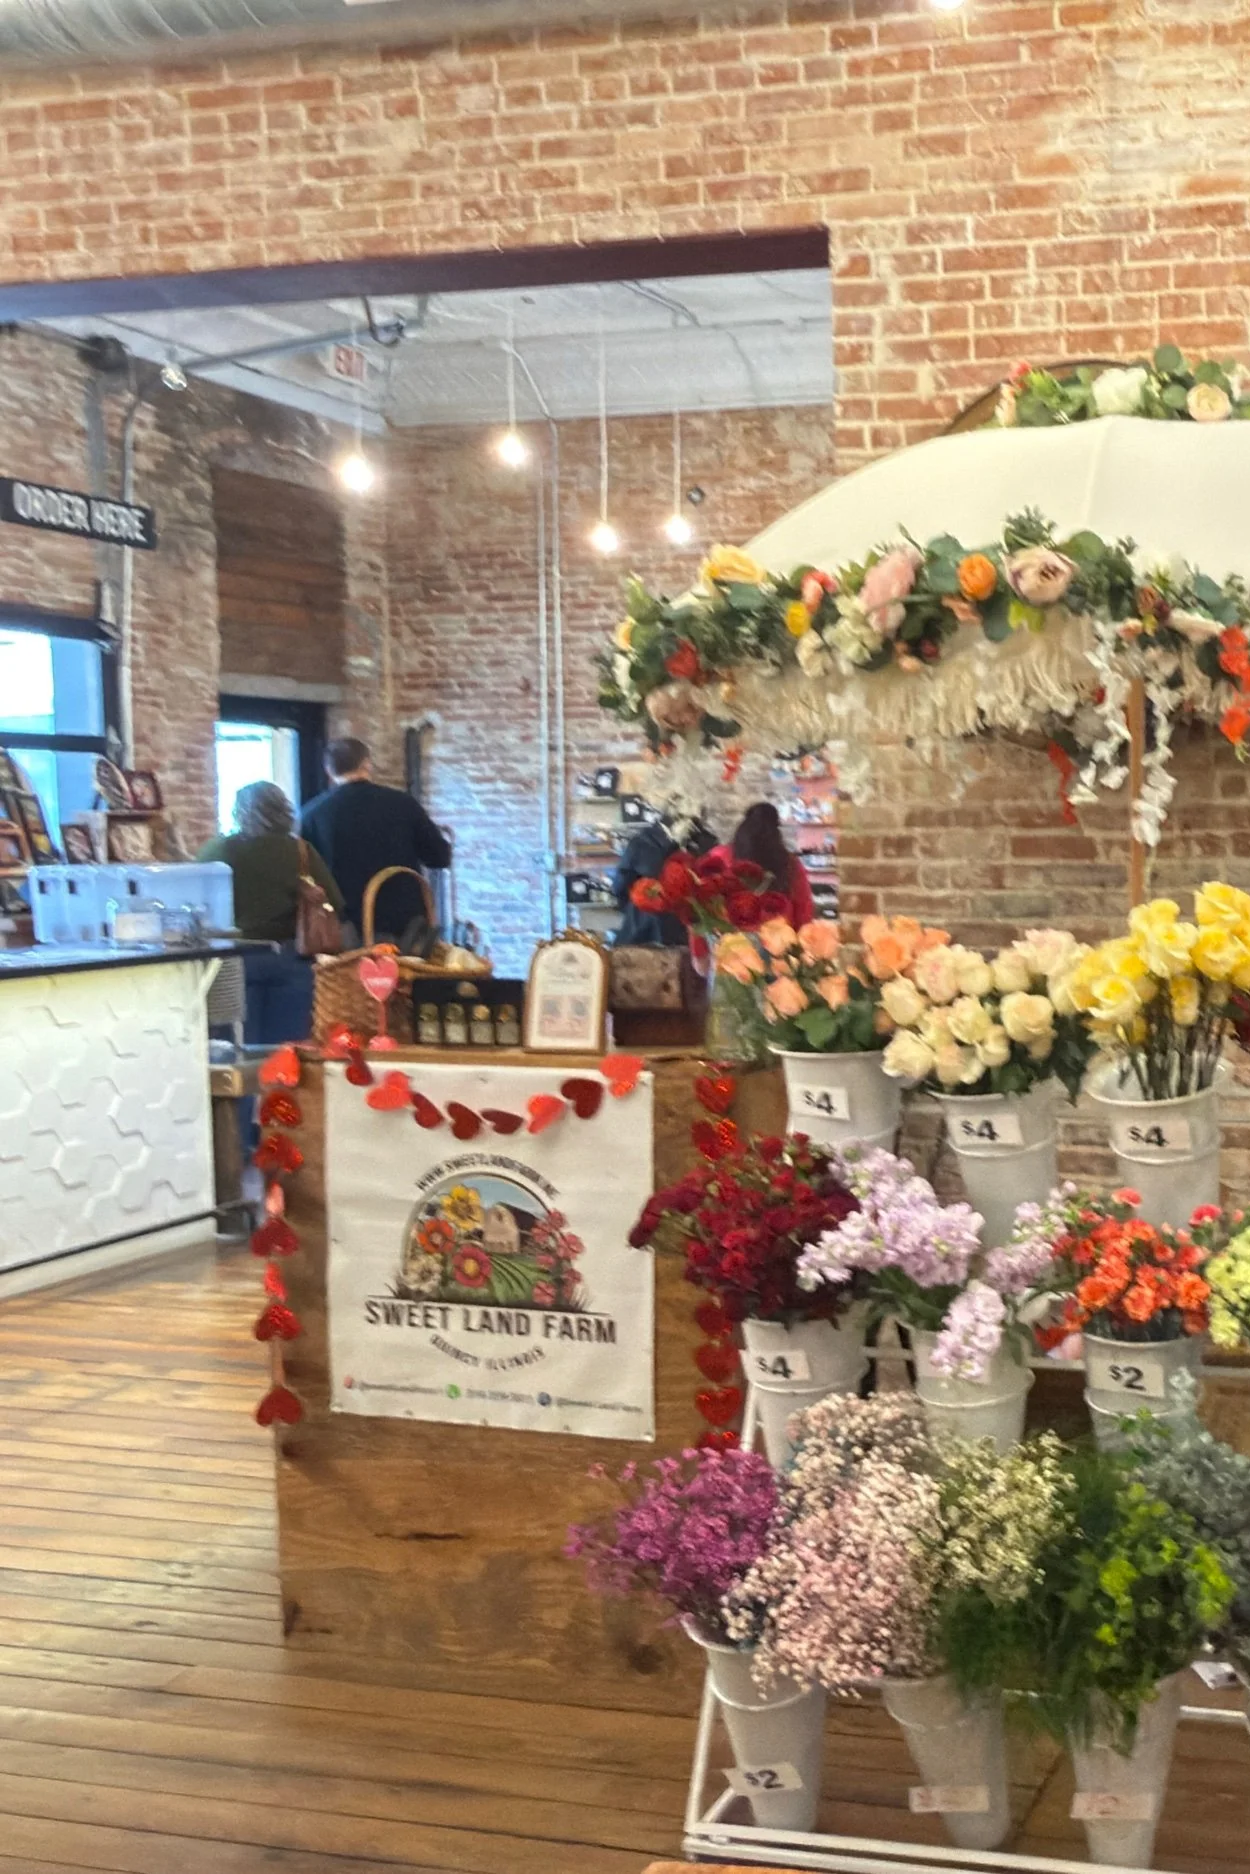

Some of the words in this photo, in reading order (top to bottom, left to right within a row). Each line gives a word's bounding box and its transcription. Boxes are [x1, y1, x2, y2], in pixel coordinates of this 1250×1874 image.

[13, 482, 91, 532] ORDER
[90, 499, 148, 544] HERE
[803, 1090, 836, 1115] $4
[961, 1119, 1000, 1142] $4
[1127, 1125, 1170, 1148] $4
[364, 1300, 452, 1331] SWEET
[463, 1307, 531, 1336] LAND
[543, 1314, 617, 1344] FARM
[756, 1355, 795, 1379] $4
[1108, 1363, 1147, 1391] $2
[743, 1769, 785, 1789] $2
